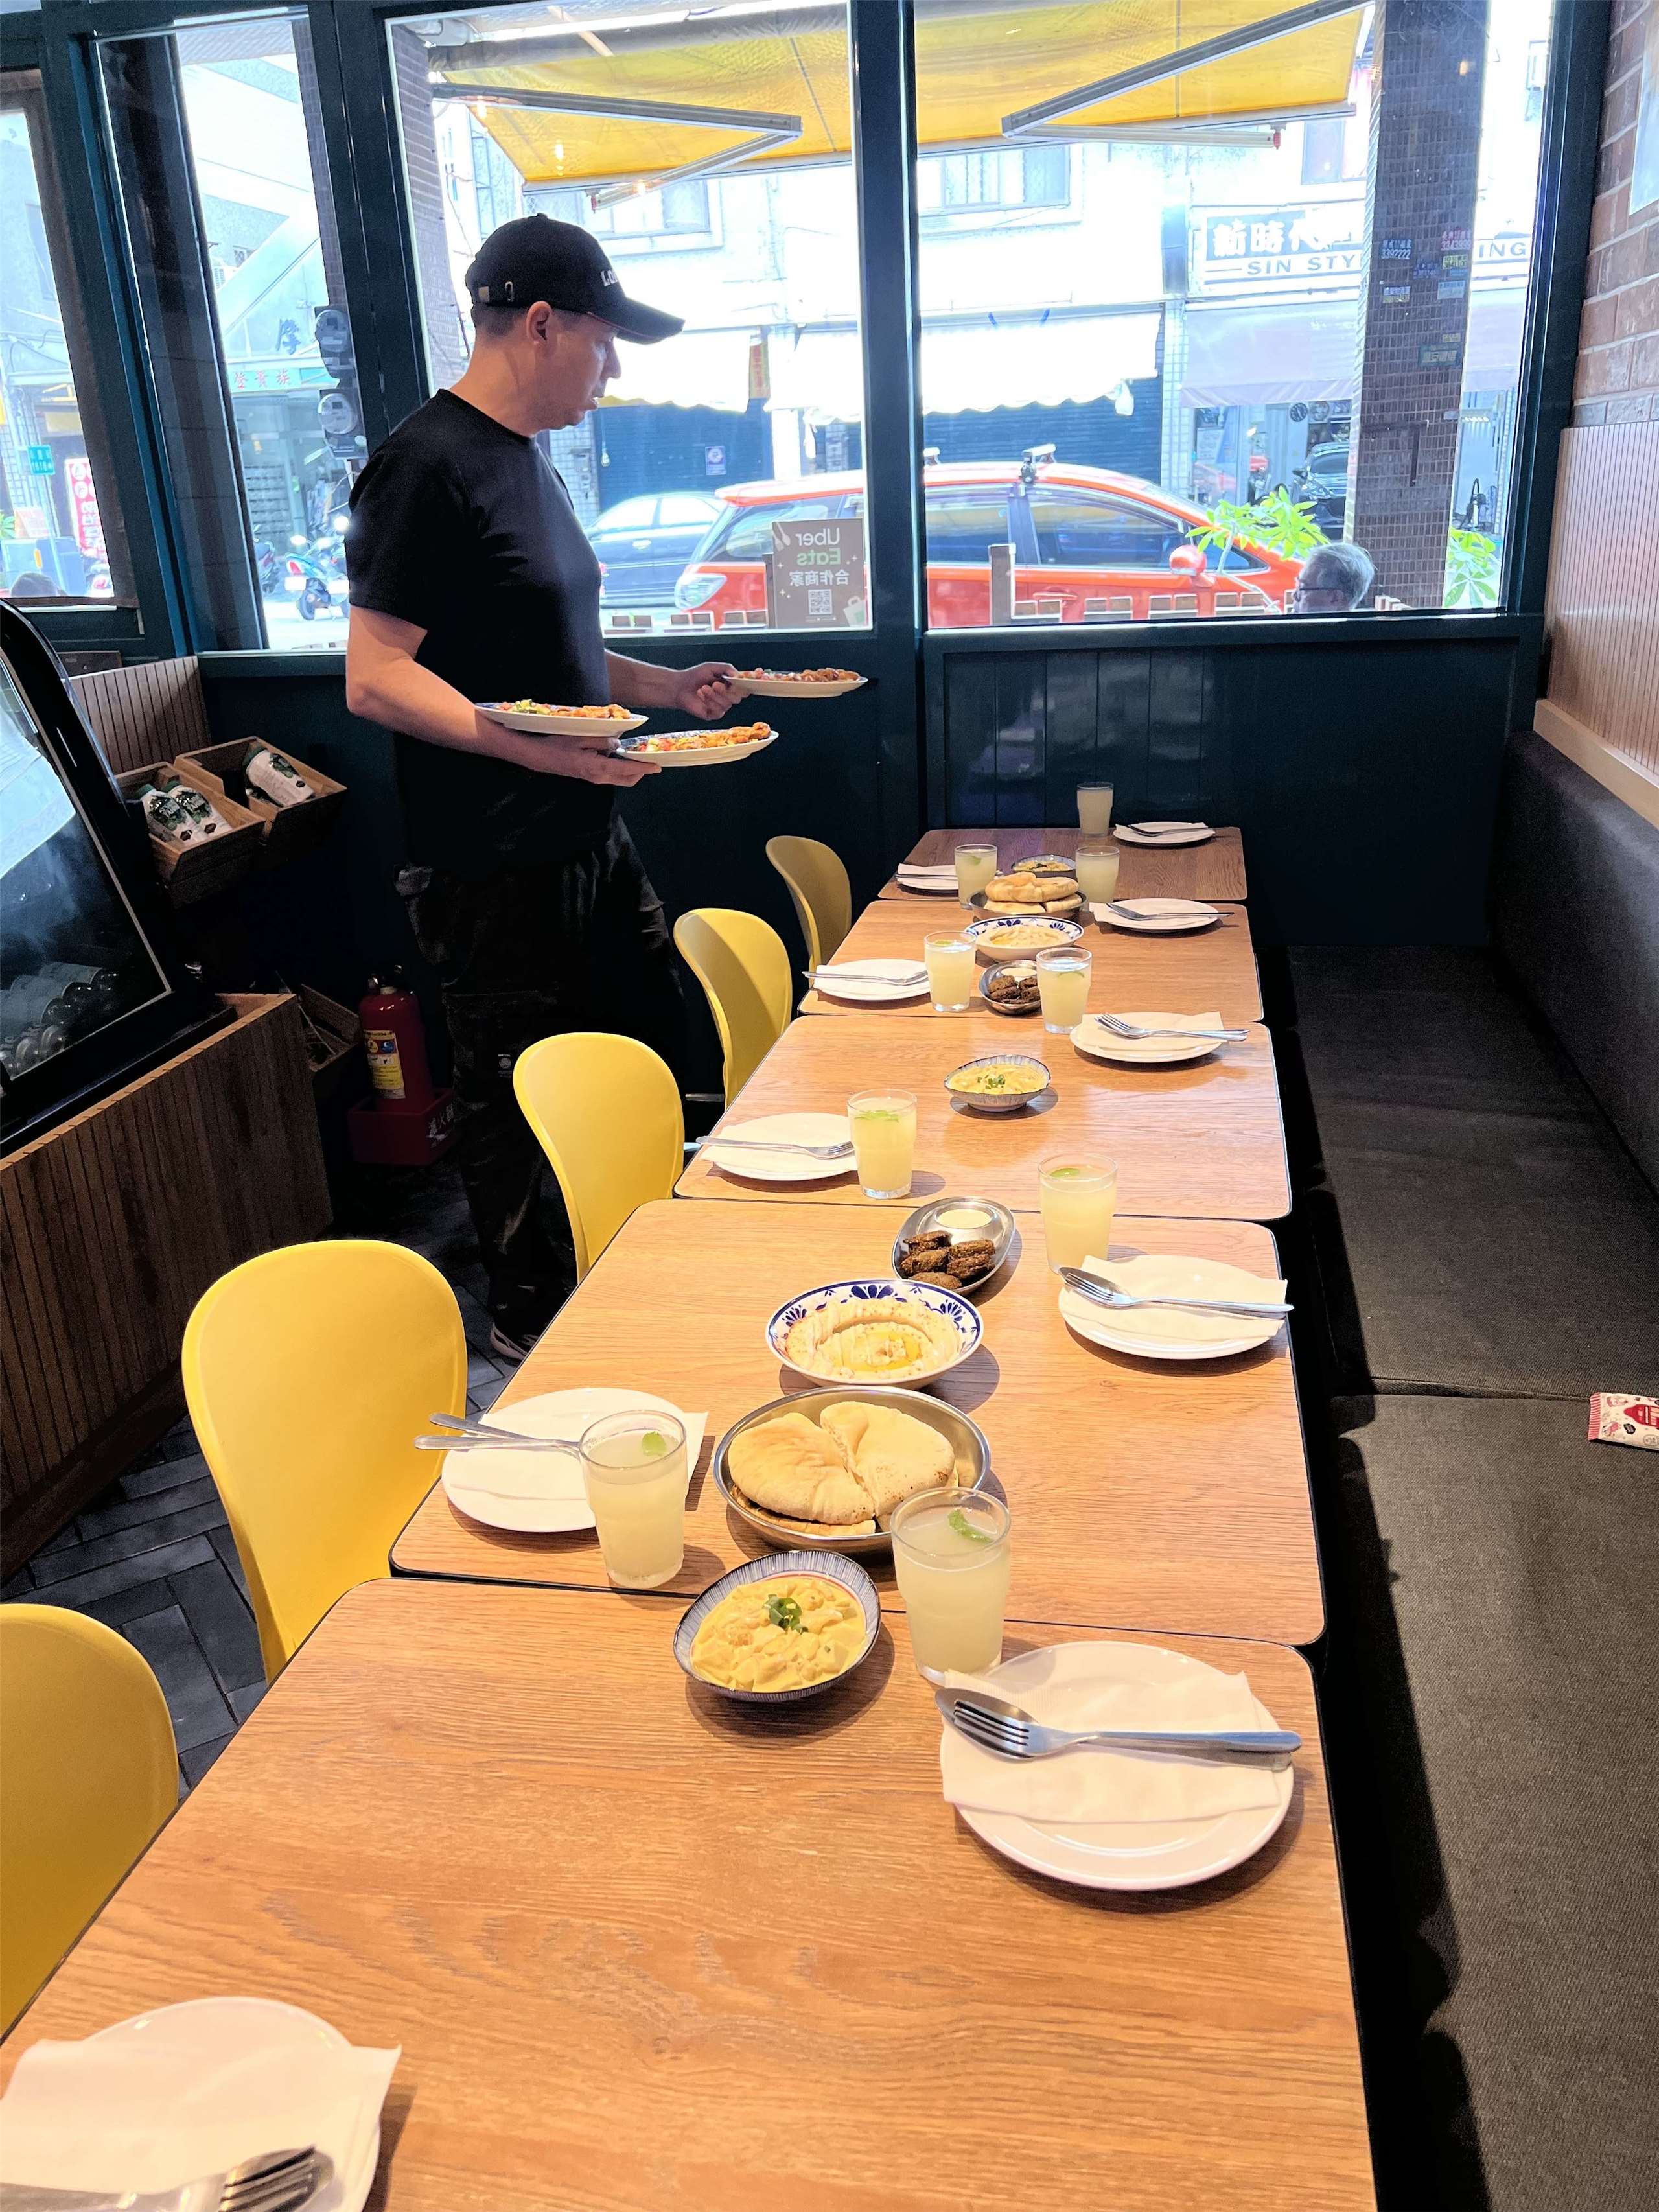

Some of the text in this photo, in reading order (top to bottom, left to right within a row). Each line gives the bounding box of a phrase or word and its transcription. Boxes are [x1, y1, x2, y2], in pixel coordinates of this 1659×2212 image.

[1247, 242, 1526, 275] SIN STY ING
